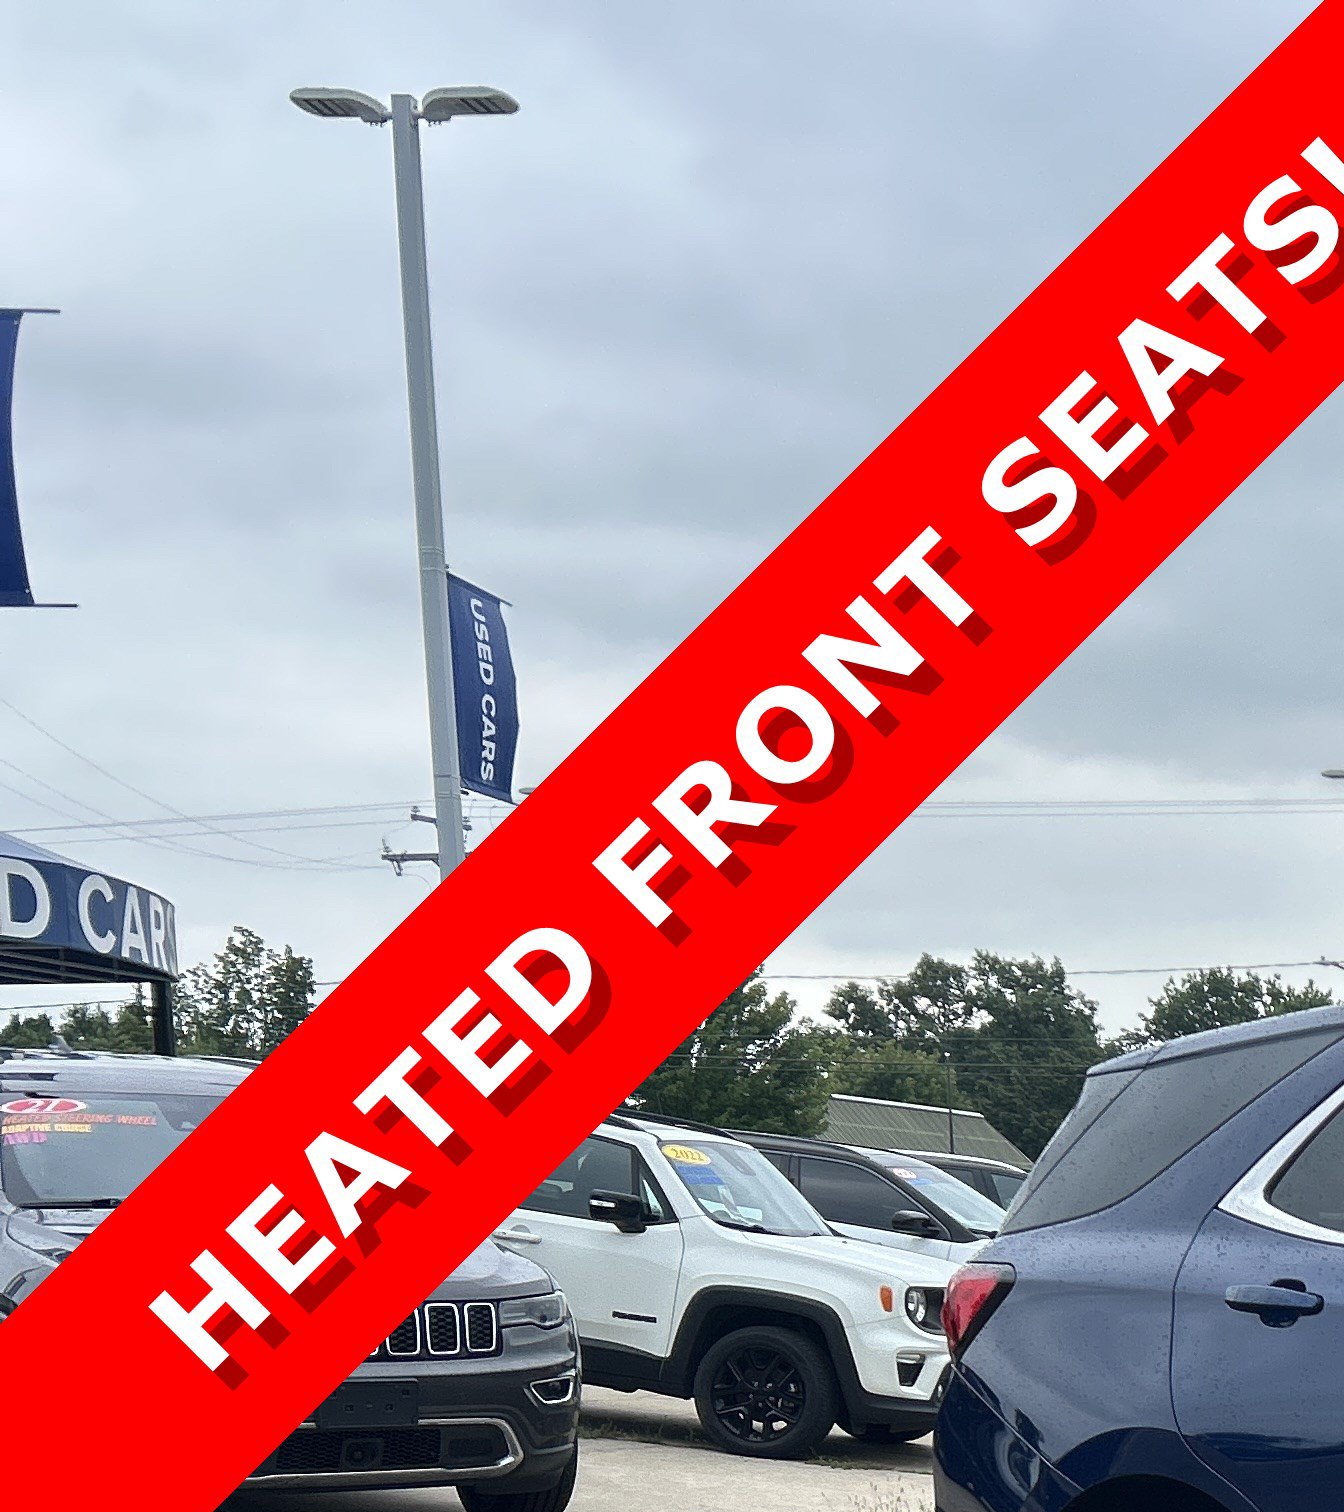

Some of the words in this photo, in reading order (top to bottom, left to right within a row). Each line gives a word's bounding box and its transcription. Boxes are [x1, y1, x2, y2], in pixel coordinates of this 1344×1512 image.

[470, 597, 495, 686] USED
[480, 693, 497, 782] CARS
[670, 1147, 704, 1162] 2022
